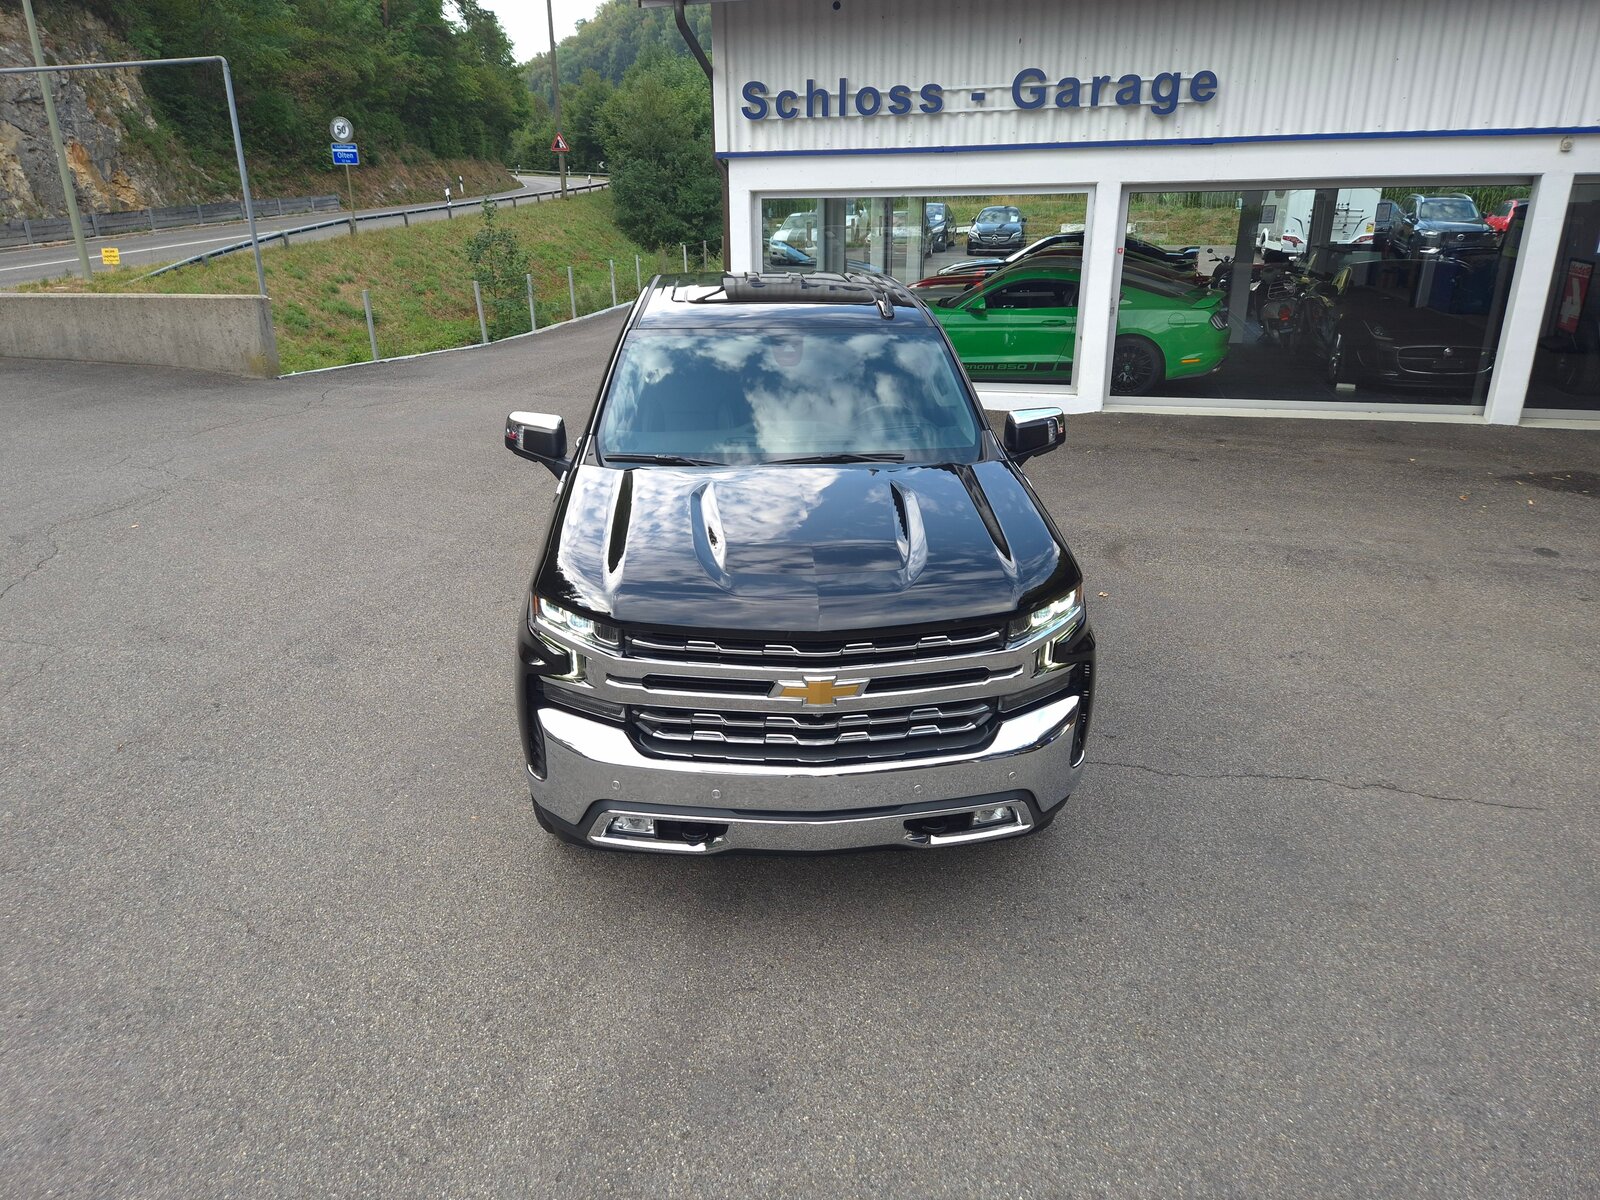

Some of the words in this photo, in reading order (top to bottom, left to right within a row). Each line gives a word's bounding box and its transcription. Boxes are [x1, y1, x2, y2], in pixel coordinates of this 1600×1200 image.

[740, 78, 945, 121] Schloss
[1011, 67, 1219, 115] Garage
[336, 125, 347, 135] 50
[337, 151, 354, 159] Olten
